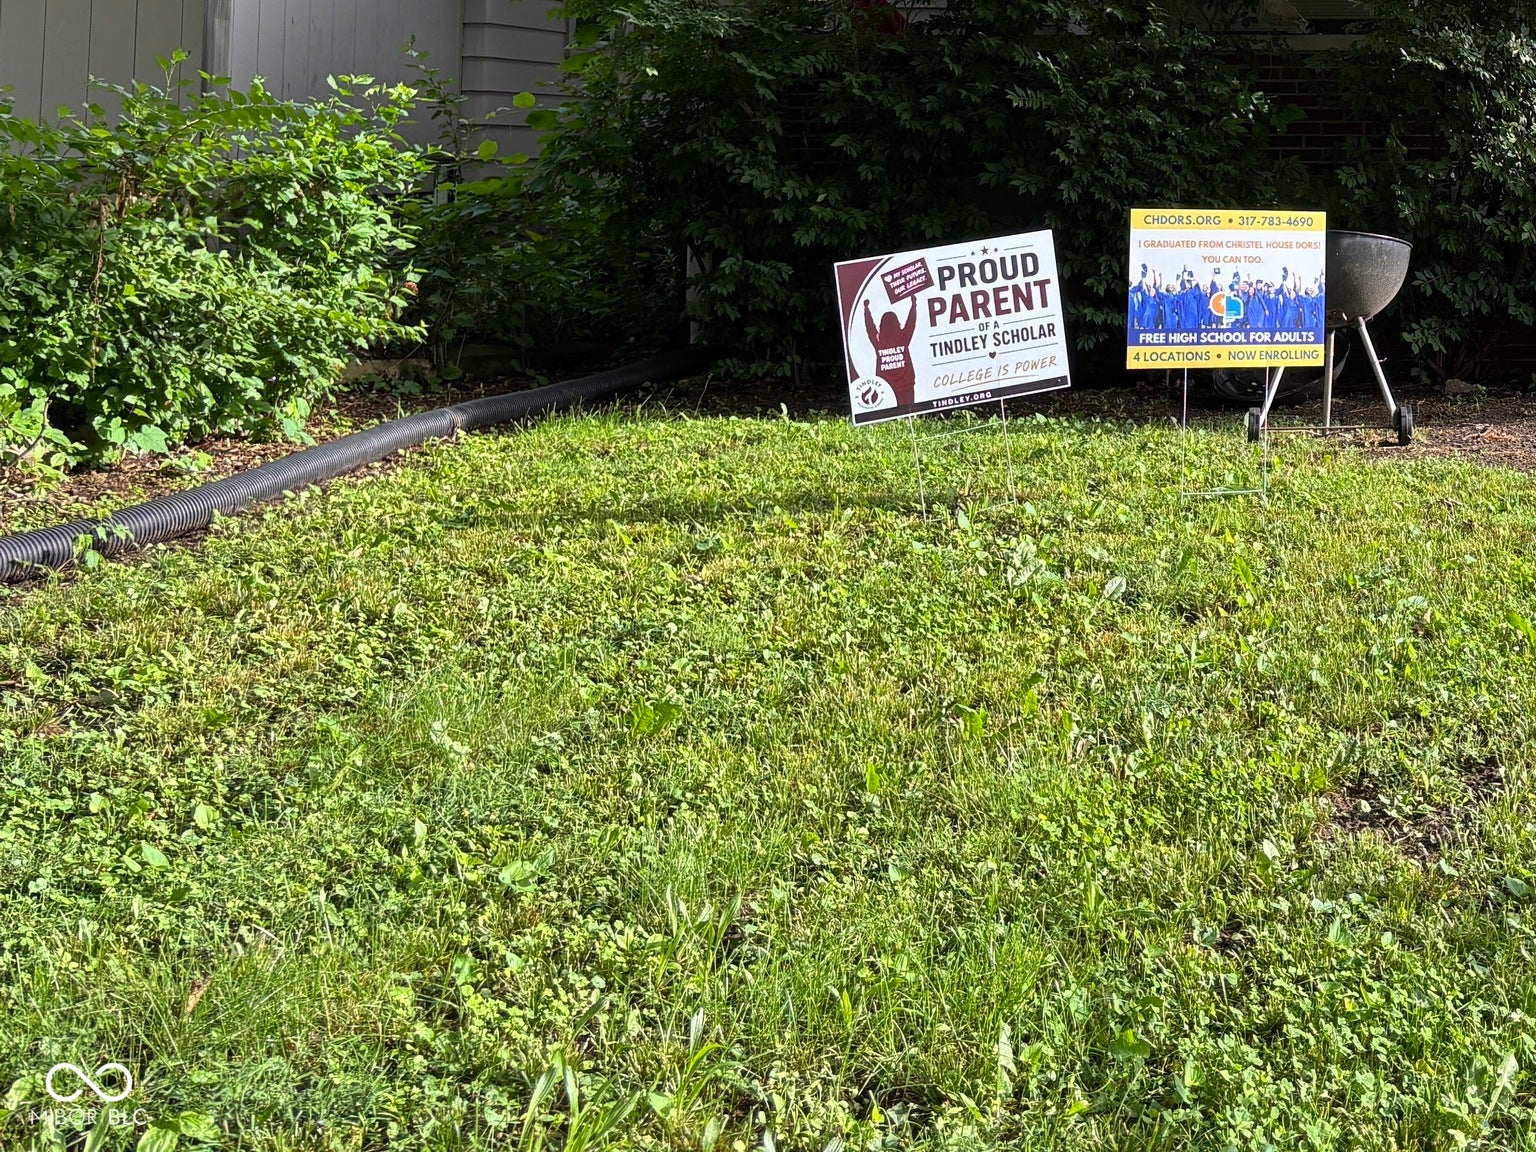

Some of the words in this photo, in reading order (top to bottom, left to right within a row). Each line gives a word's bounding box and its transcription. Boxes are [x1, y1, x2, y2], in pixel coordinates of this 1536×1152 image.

[1143, 214, 1222, 226] CHDORS.ORG
[1238, 216, 1314, 227] 317-783-4690
[1143, 239, 1197, 248] GRADUATED
[1198, 240, 1224, 248] FROM
[1225, 240, 1264, 249] CHRISTEL
[1265, 241, 1294, 249] HOUSE
[1295, 241, 1321, 250] DORS!
[1201, 255, 1222, 264] YOU
[1223, 255, 1243, 264] CAN
[1243, 255, 1264, 264] TOO.
[937, 252, 1040, 292] PROUD
[927, 278, 1051, 328] PARENT
[978, 321, 990, 332] OF
[993, 320, 1000, 329] A
[930, 333, 988, 358] TINDLEY
[992, 322, 1057, 347] SCHOLAR
[1139, 332, 1166, 344] FREE
[1168, 332, 1198, 343] HIGH
[1199, 332, 1248, 343] SCHOOL
[1249, 332, 1271, 343] FOR
[1272, 331, 1316, 342] ADULTS
[878, 346, 905, 357] TINDLEY
[1132, 352, 1141, 362] 4
[1143, 351, 1211, 362] LOCATIONS
[1227, 350, 1257, 361] NOW
[1258, 349, 1320, 360] ENROLLING
[880, 360, 906, 371] PARENT
[881, 354, 904, 364] PROUD
[933, 366, 993, 388] COLLEGE
[997, 364, 1009, 377] IS
[1014, 355, 1057, 374] POWER
[932, 391, 992, 408] TINDLEY.ORG
